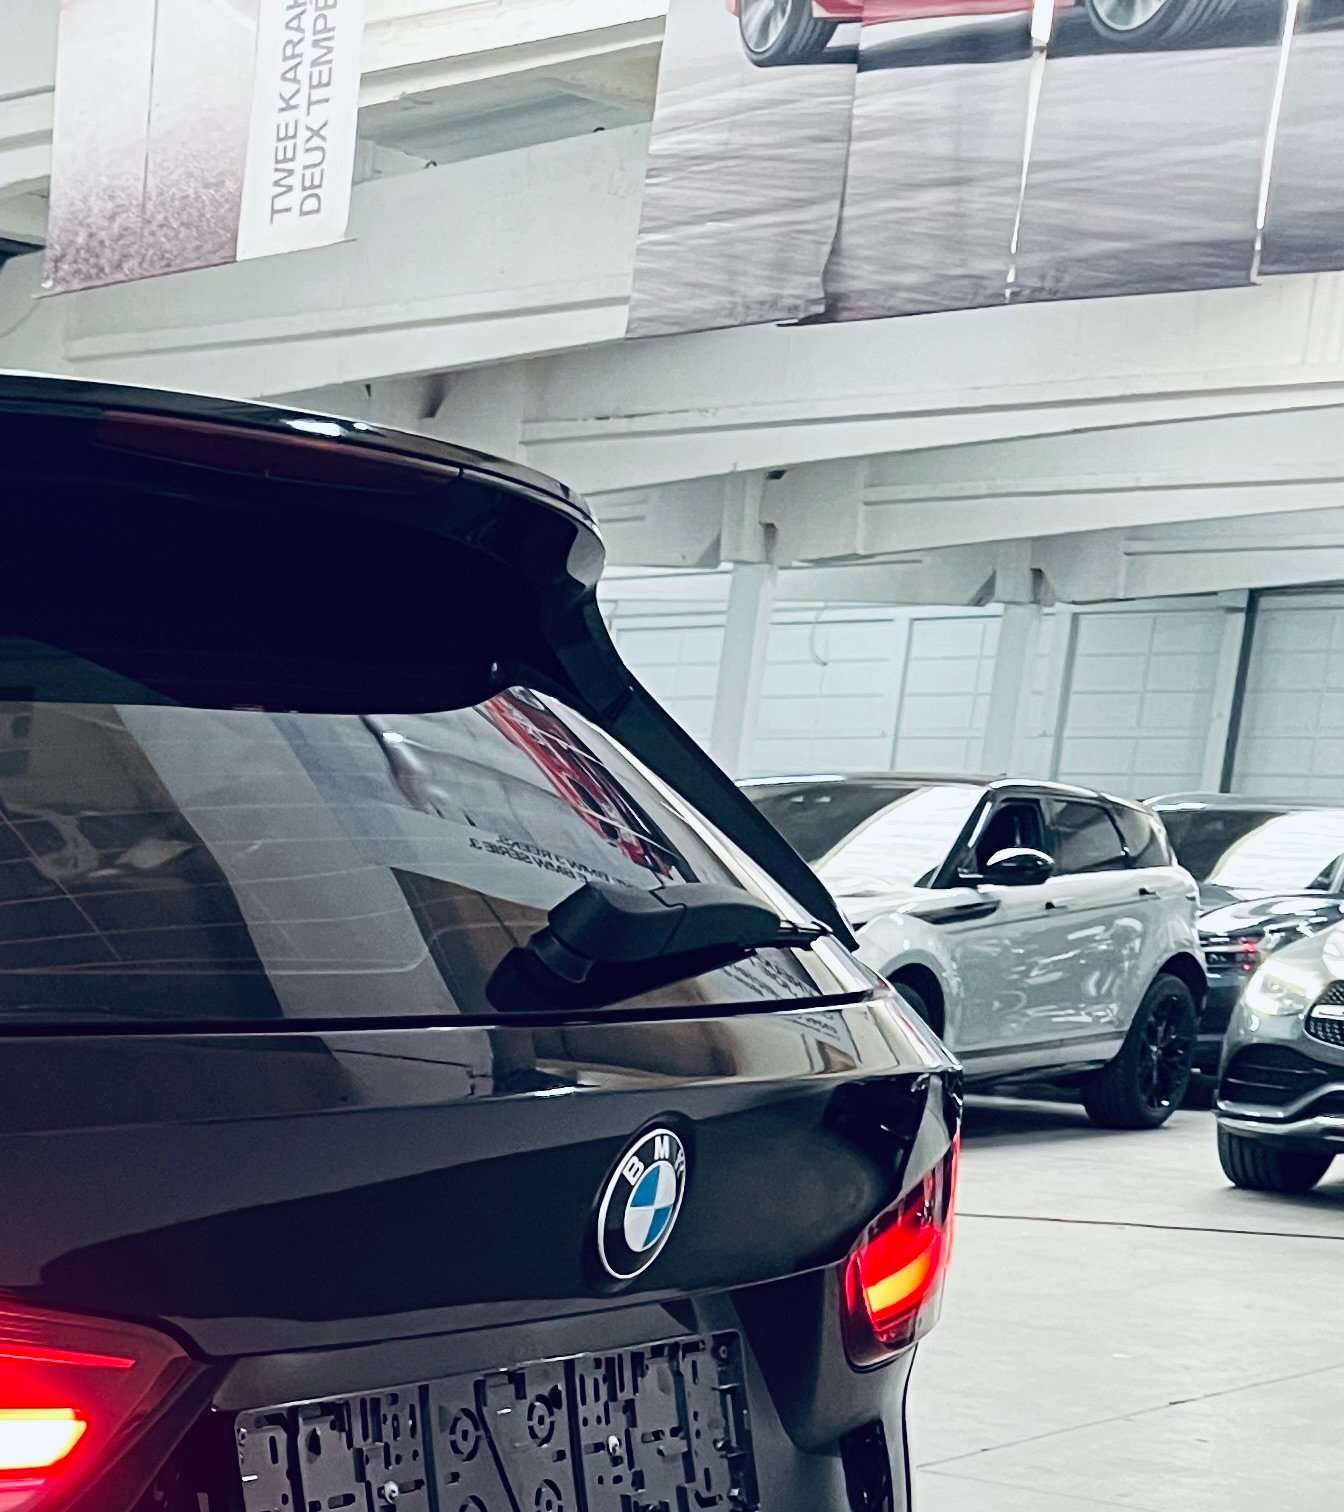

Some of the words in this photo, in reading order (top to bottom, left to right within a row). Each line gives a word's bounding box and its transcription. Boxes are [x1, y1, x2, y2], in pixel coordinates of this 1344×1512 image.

[270, 119, 298, 224] TWEE
[299, 119, 330, 217] DEUX
[622, 1134, 686, 1186] BMW
